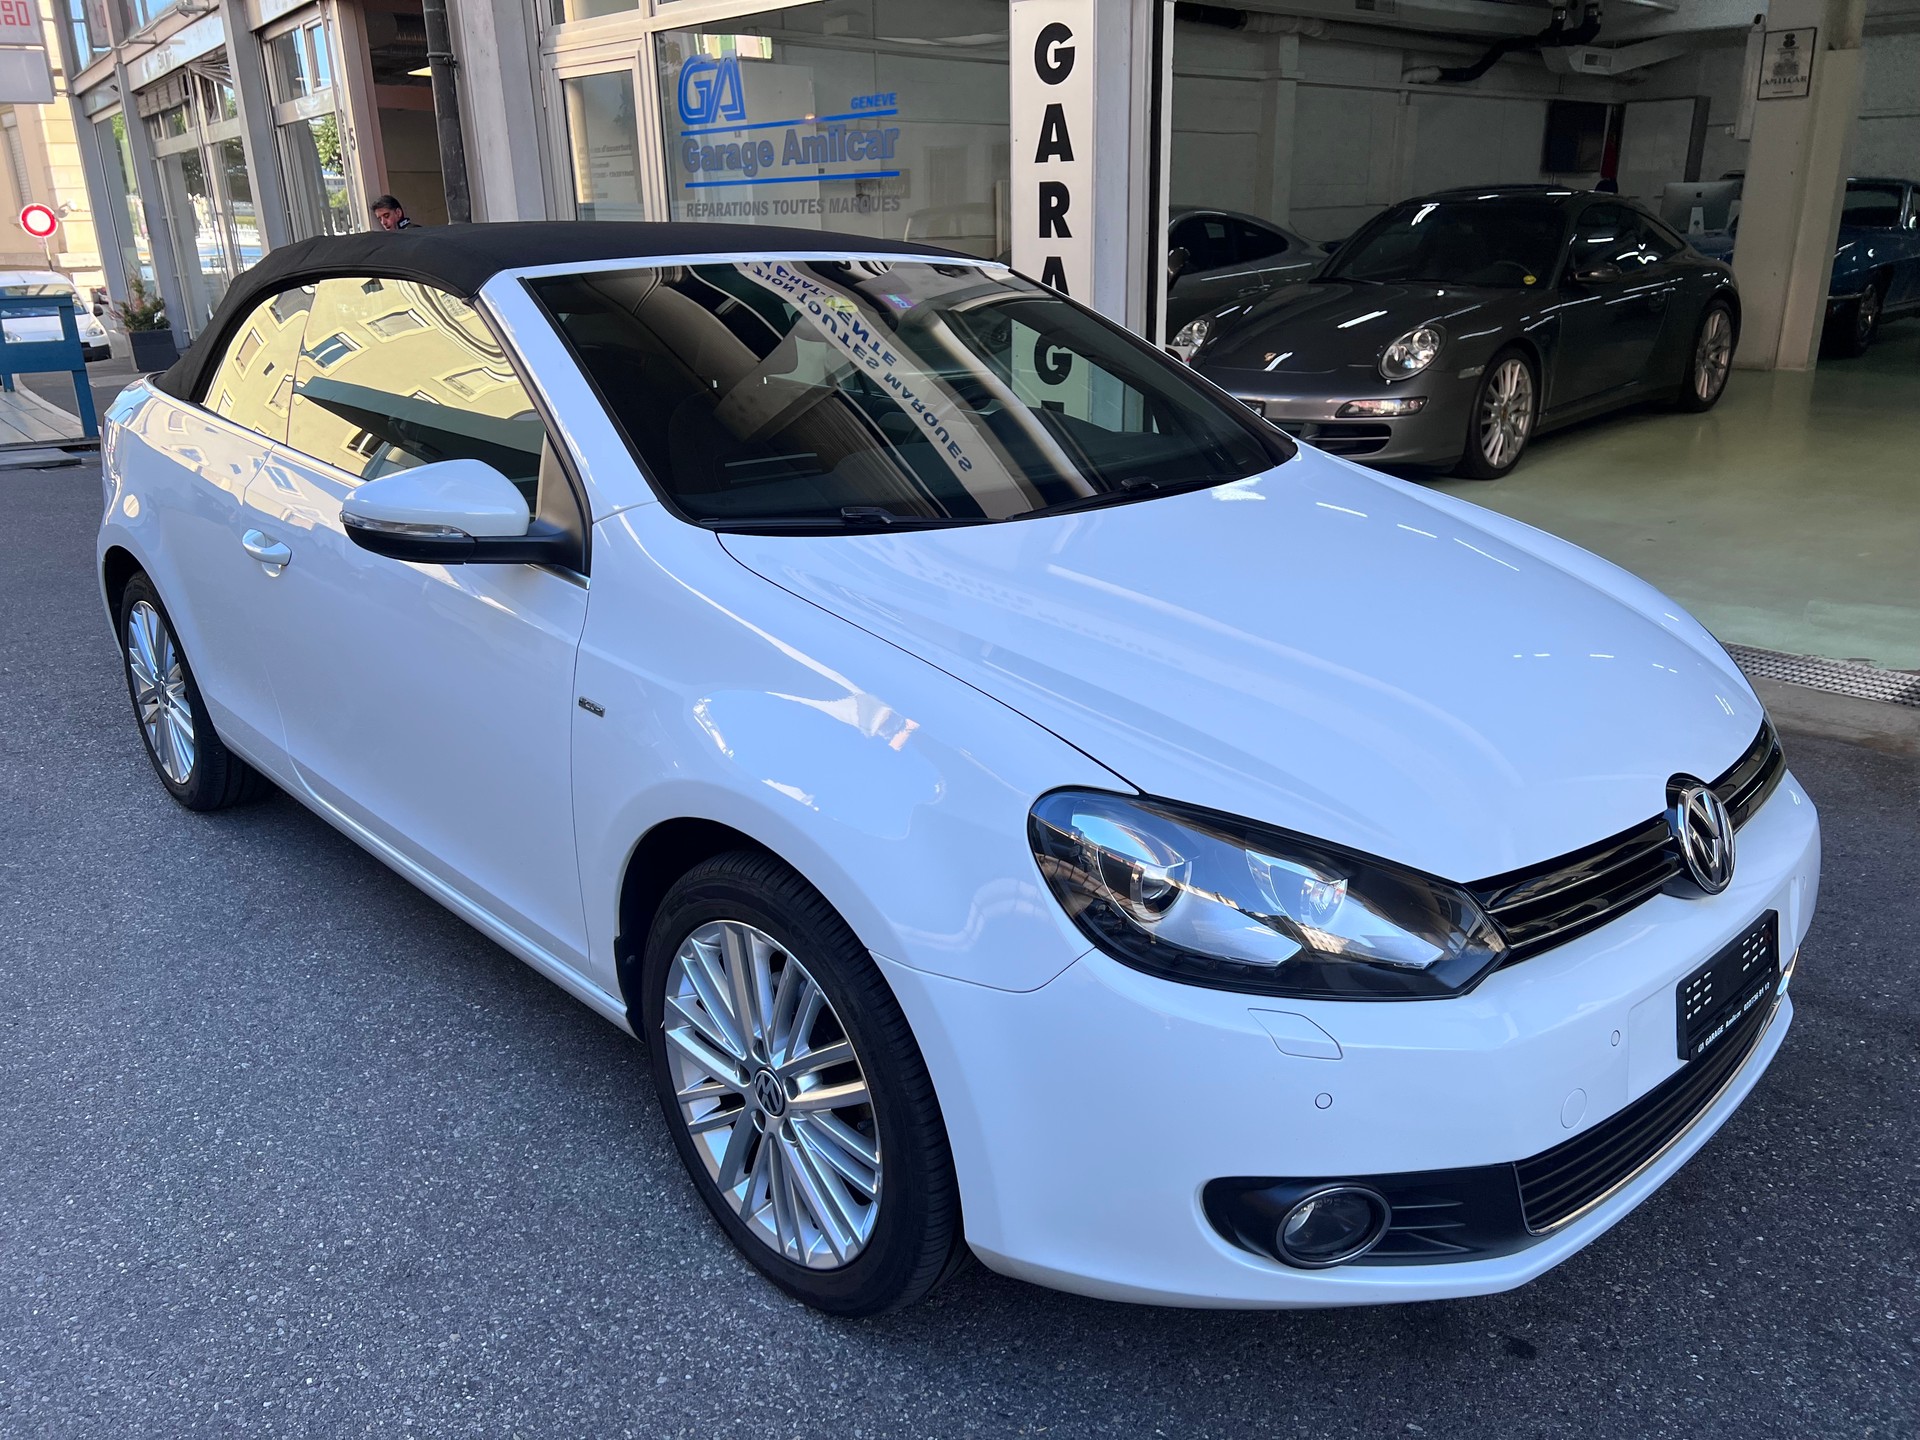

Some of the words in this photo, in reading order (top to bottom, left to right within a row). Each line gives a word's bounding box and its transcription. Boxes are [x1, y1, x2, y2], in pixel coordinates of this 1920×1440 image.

[682, 138, 774, 177] Garage
[782, 124, 899, 166] Amilcar
[686, 199, 768, 217] RÉPARATIONS
[772, 198, 825, 215] TOUTES
[829, 195, 900, 214] MARQUES
[1034, 21, 1076, 414] GARAG
